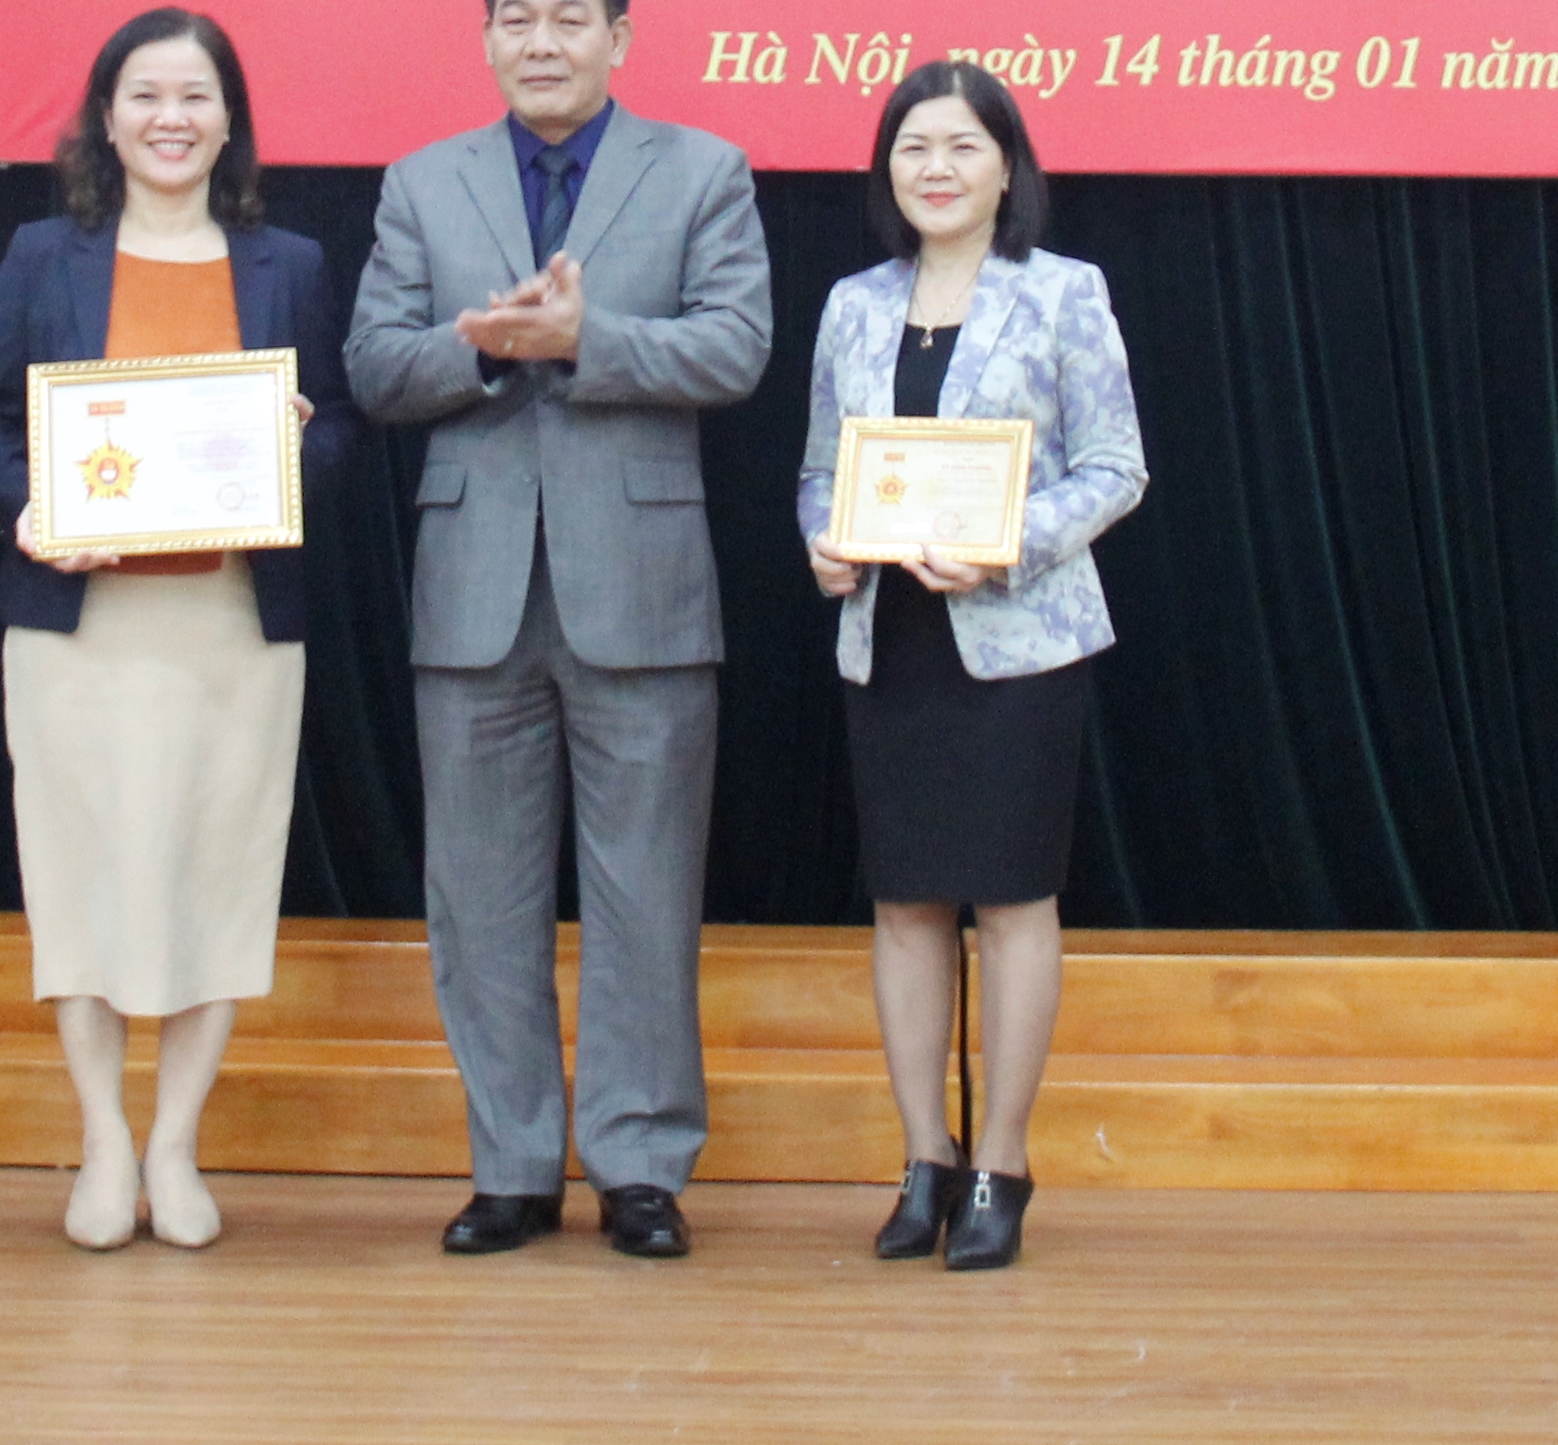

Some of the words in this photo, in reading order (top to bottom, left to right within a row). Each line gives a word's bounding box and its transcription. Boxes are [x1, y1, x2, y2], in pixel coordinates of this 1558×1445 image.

[701, 30, 789, 85] Hà
[1095, 32, 1162, 87] 14
[1176, 32, 1343, 103] tháng
[1355, 34, 1422, 90] 01
